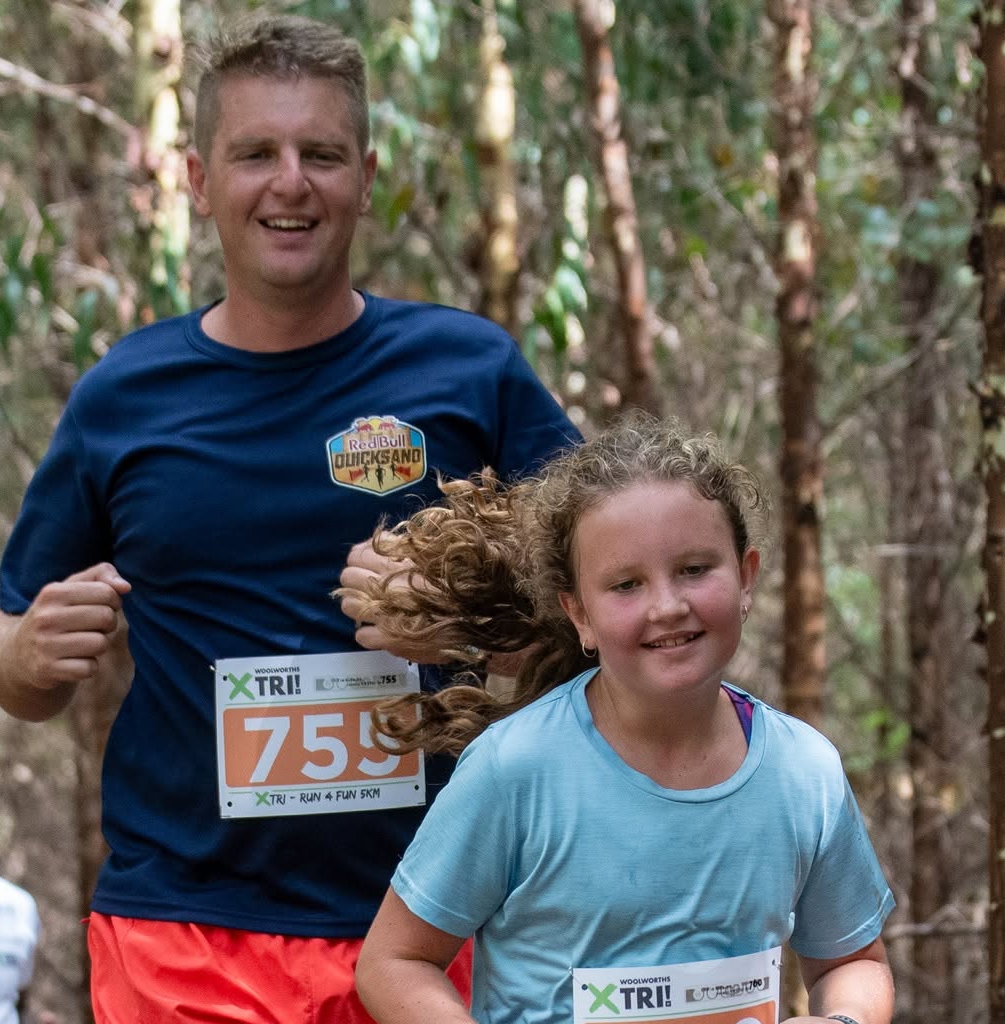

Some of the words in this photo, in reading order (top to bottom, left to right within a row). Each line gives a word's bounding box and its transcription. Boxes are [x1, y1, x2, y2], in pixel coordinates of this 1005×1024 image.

[334, 449, 421, 469] QUICKSAND
[254, 666, 301, 674] WOOLWORTHS
[380, 674, 397, 685] 755
[243, 711, 402, 784] 755
[300, 791, 321, 803] RUN
[324, 791, 333, 801] 4
[336, 788, 357, 800] FUN
[360, 787, 381, 799] 5KM
[619, 976, 671, 985] WOOLWORTHS
[749, 978, 763, 991] 760
